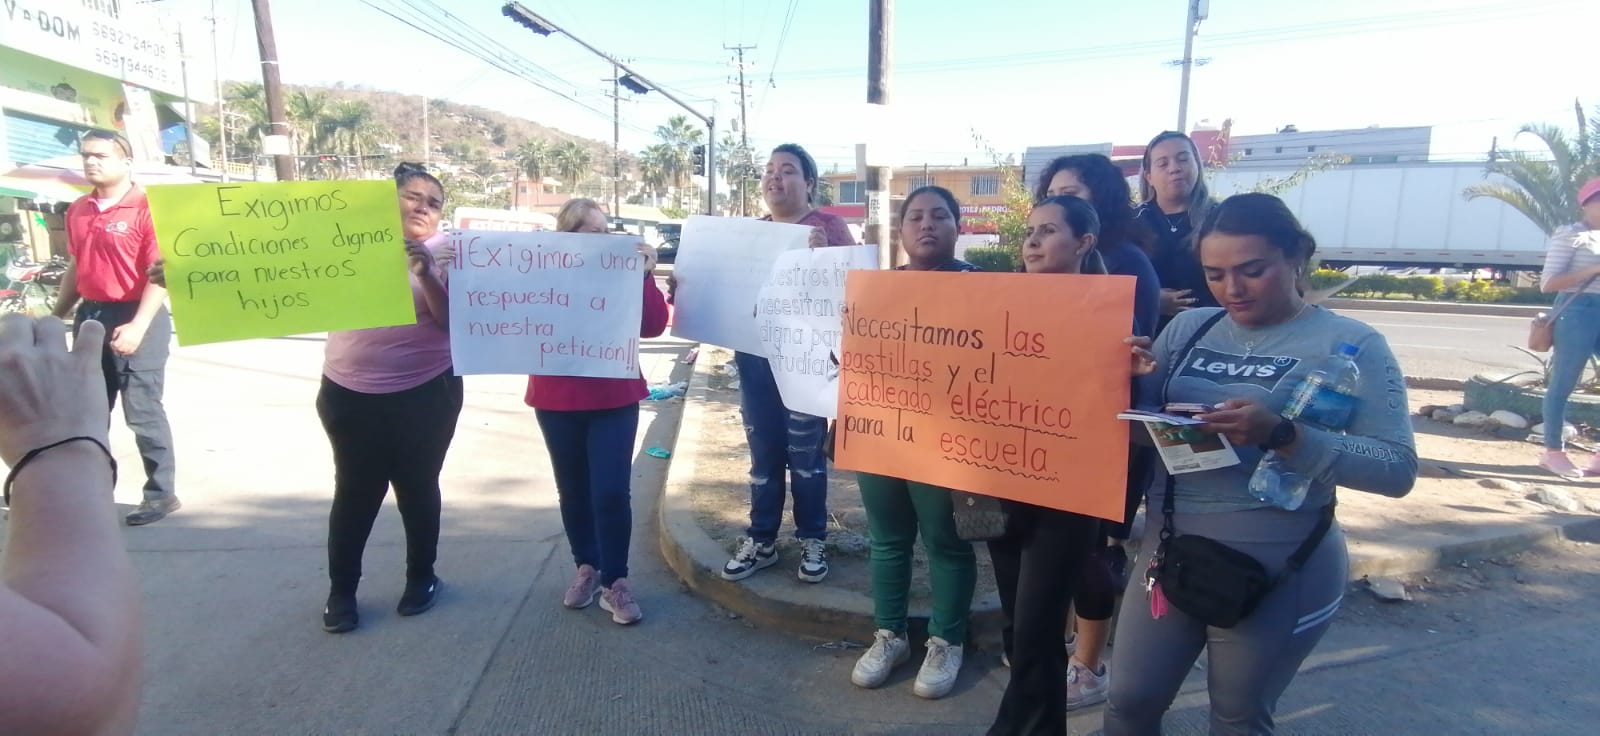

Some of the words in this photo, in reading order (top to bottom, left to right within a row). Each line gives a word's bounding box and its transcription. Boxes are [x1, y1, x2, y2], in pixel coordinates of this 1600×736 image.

[217, 186, 348, 231] Exigimos
[174, 227, 309, 258] Condiciones
[332, 222, 394, 254] dignas
[187, 269, 241, 300] para
[254, 259, 357, 283] nuestros
[600, 251, 638, 271] una
[237, 289, 310, 320] hijos
[467, 287, 570, 311] respuesta
[590, 296, 607, 312] a
[469, 316, 555, 337] nuestra
[845, 302, 984, 350] Necesitamos
[1003, 310, 1046, 353] las
[540, 335, 637, 372] petición!!
[842, 339, 934, 385] pastillas
[946, 364, 961, 394] y
[974, 352, 996, 385] el
[846, 371, 932, 411] cableado
[950, 382, 1072, 430] eléctrico
[842, 414, 886, 449] para
[896, 408, 915, 443] la
